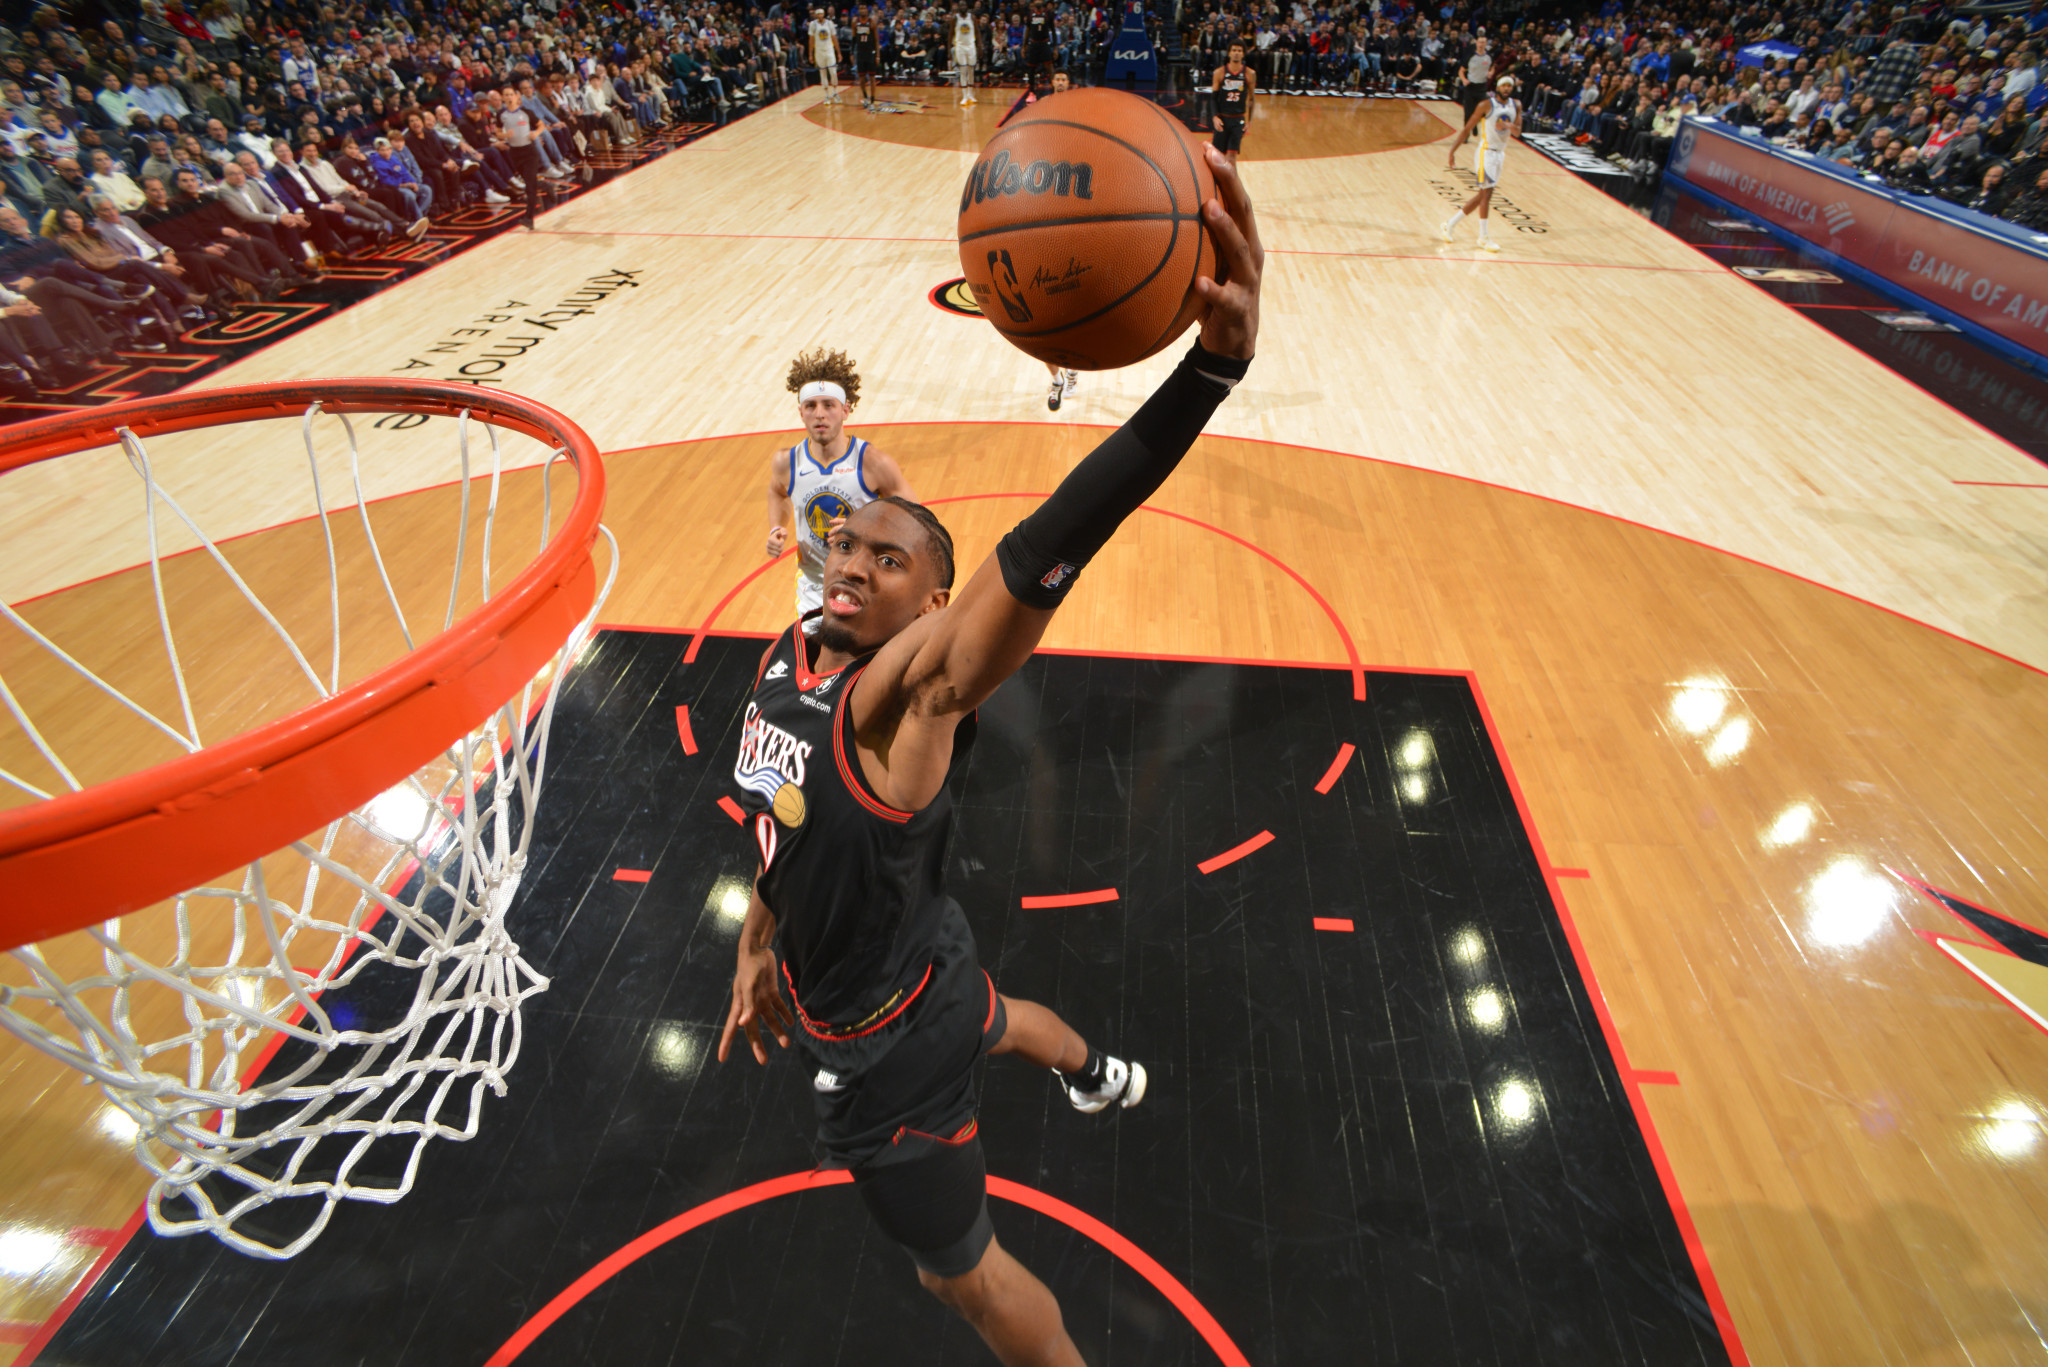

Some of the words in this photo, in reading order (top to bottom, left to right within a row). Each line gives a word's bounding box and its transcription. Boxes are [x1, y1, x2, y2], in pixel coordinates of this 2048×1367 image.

[1226, 91, 1240, 102] 25
[1706, 161, 1738, 188] BANK
[1738, 175, 1756, 195] OF
[1754, 185, 1818, 225] AMERICA
[523, 268, 644, 332] xfinity
[1907, 249, 1972, 294] BANK
[1970, 278, 2008, 307] OF
[392, 299, 531, 372] ARENA
[802, 484, 830, 503] GOLDEN
[832, 486, 853, 502] STATE
[799, 693, 831, 714] crypto.com
